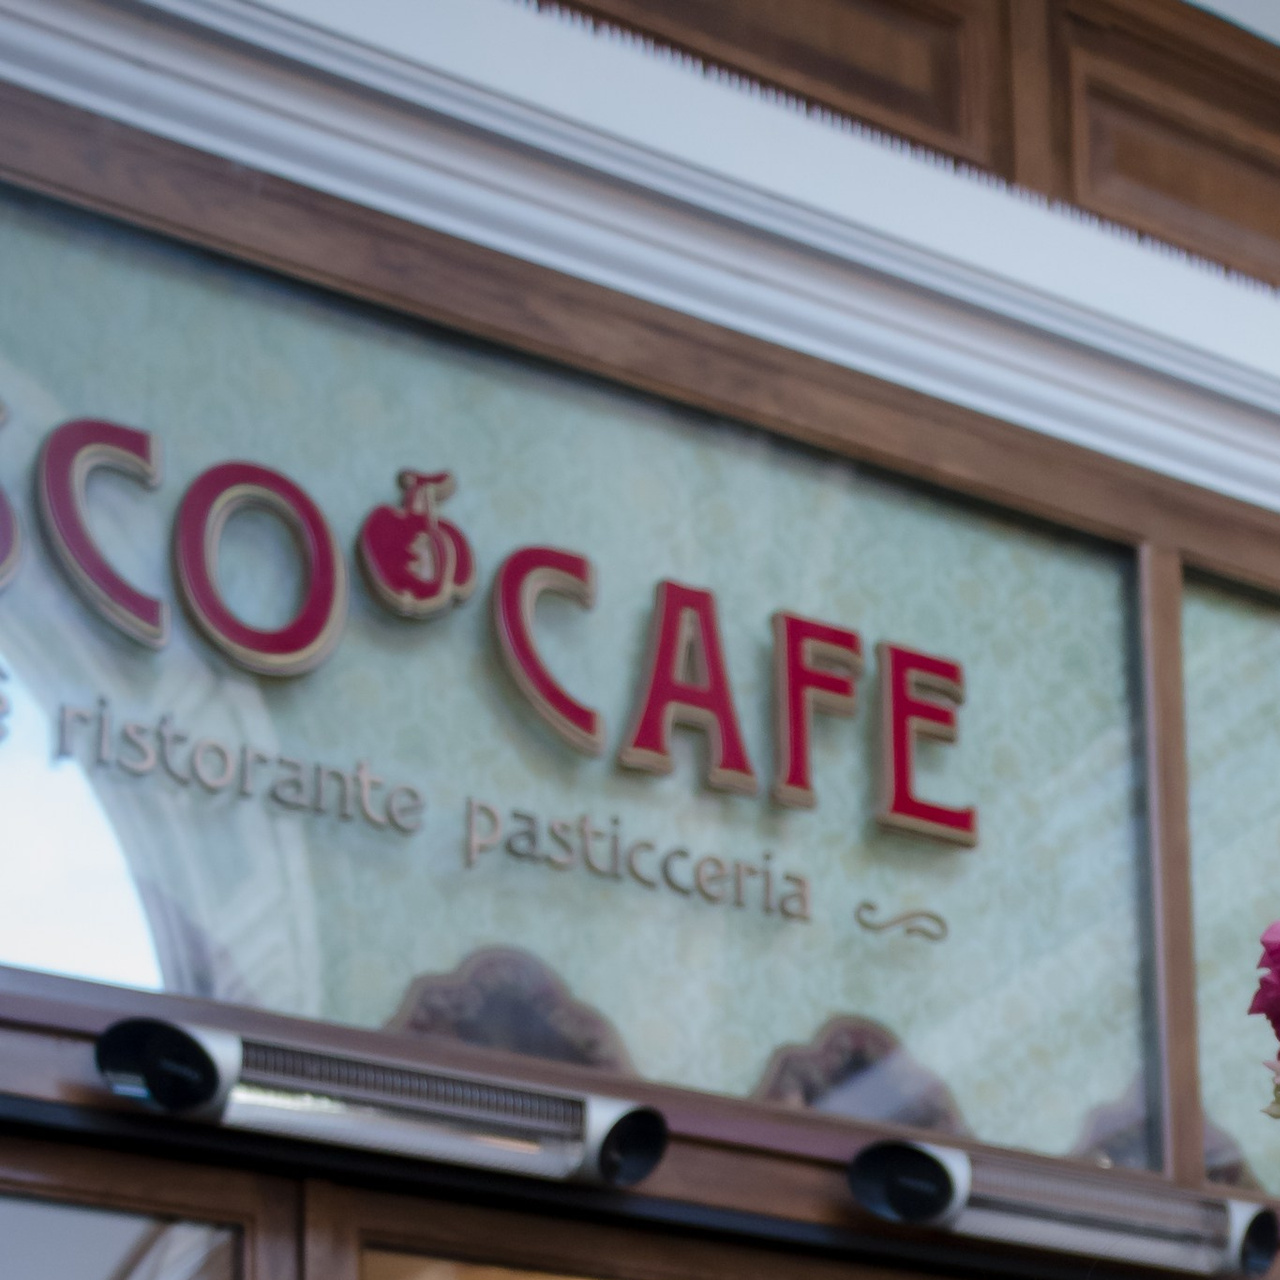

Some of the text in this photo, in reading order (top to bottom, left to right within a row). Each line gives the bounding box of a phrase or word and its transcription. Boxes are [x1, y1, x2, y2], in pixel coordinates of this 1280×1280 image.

[0, 402, 979, 848] CO CAFE
[56, 696, 425, 835] ristorante
[463, 797, 813, 922] pasticceria
